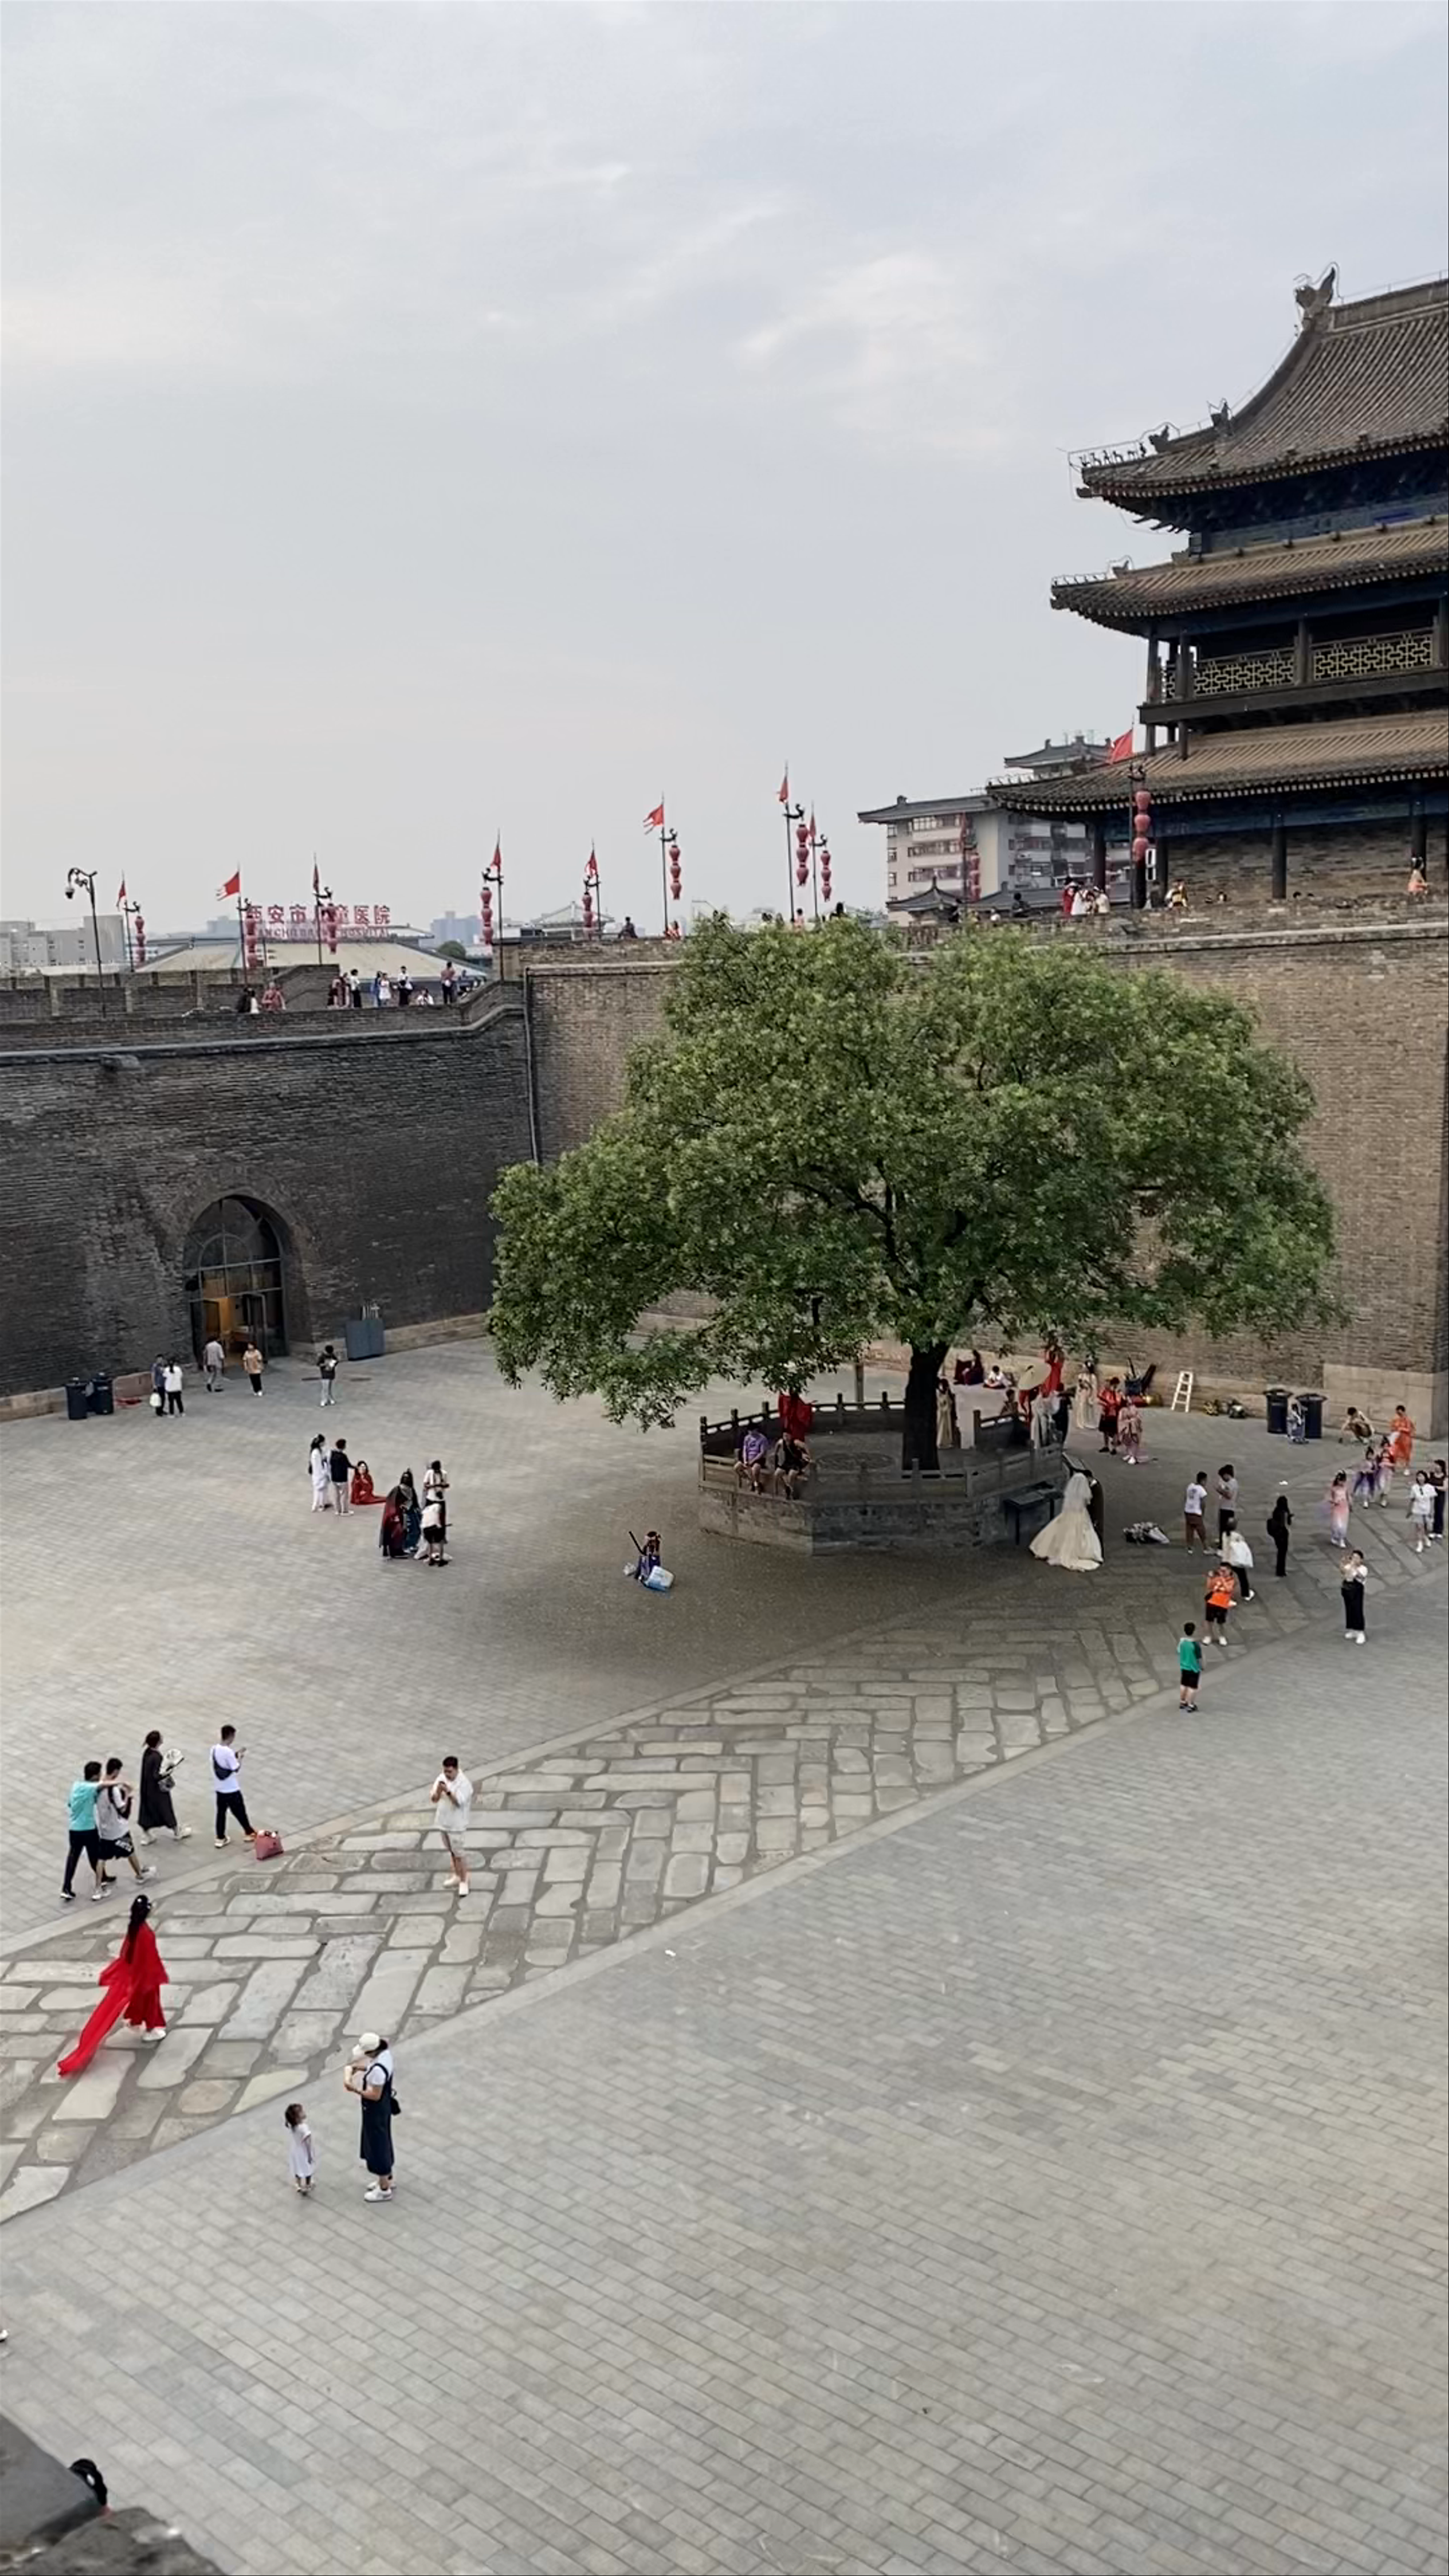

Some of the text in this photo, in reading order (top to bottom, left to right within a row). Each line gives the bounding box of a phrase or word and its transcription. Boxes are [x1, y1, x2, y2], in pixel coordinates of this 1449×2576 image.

[246, 904, 390, 924] 西安市童医院
